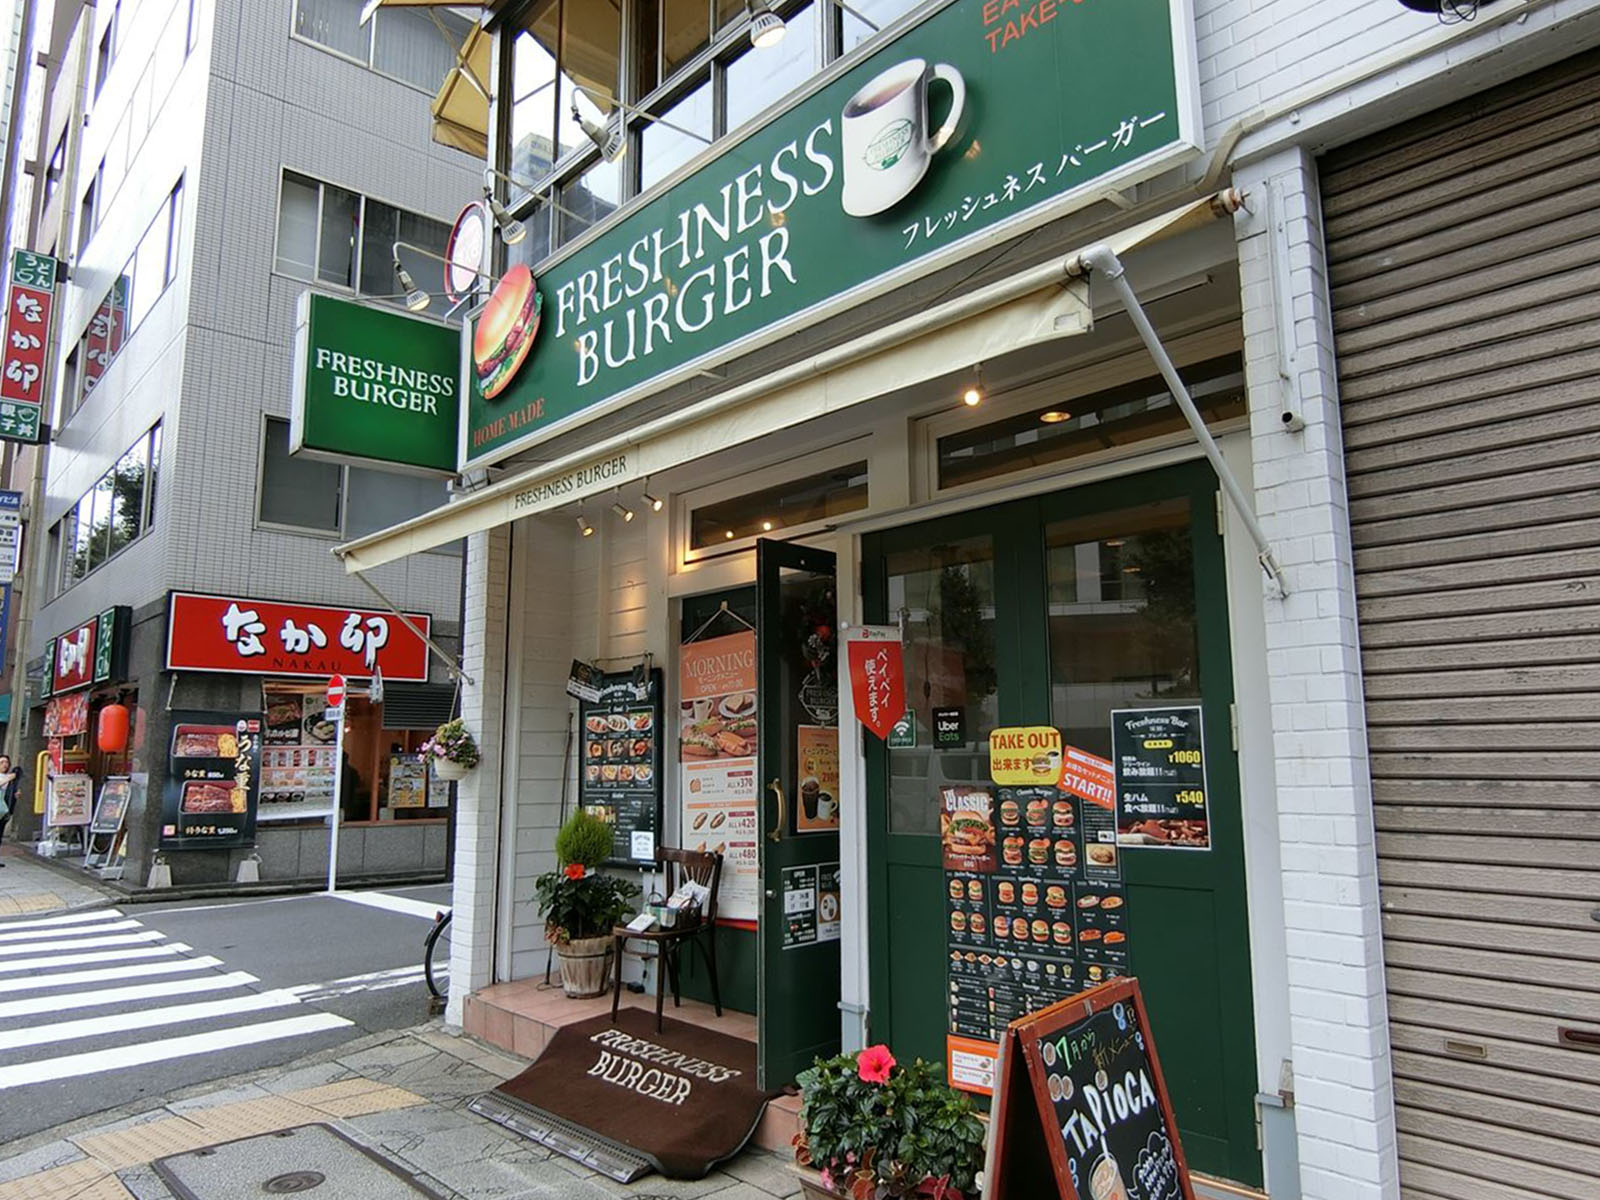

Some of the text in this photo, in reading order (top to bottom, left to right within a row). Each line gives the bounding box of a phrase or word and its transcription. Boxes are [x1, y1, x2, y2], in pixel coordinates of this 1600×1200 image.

[555, 119, 834, 338] FRESHNESS
[577, 227, 797, 387] BURGER
[6, 293, 44, 393] なか卯
[316, 347, 454, 397] FRESHNESS
[334, 376, 437, 415] BURGER
[474, 398, 545, 448] HOME MADE
[514, 455, 627, 510] FRESHNESS BURGER
[222, 603, 389, 671] なか卯
[272, 657, 342, 673] NAKAU
[686, 649, 754, 677] MORNING
[938, 721, 959, 732] Uber
[938, 732, 960, 741] Eats
[991, 732, 1059, 749] TAKE OUT
[1125, 715, 1189, 731] Freshness Bar
[233, 734, 252, 791] うな重
[992, 757, 1032, 771] 出来ます
[946, 795, 988, 811] CLASSIC
[1063, 772, 1112, 803] START!!
[587, 1050, 692, 1105] BURGER
[588, 1028, 742, 1083] FRESHNESS
